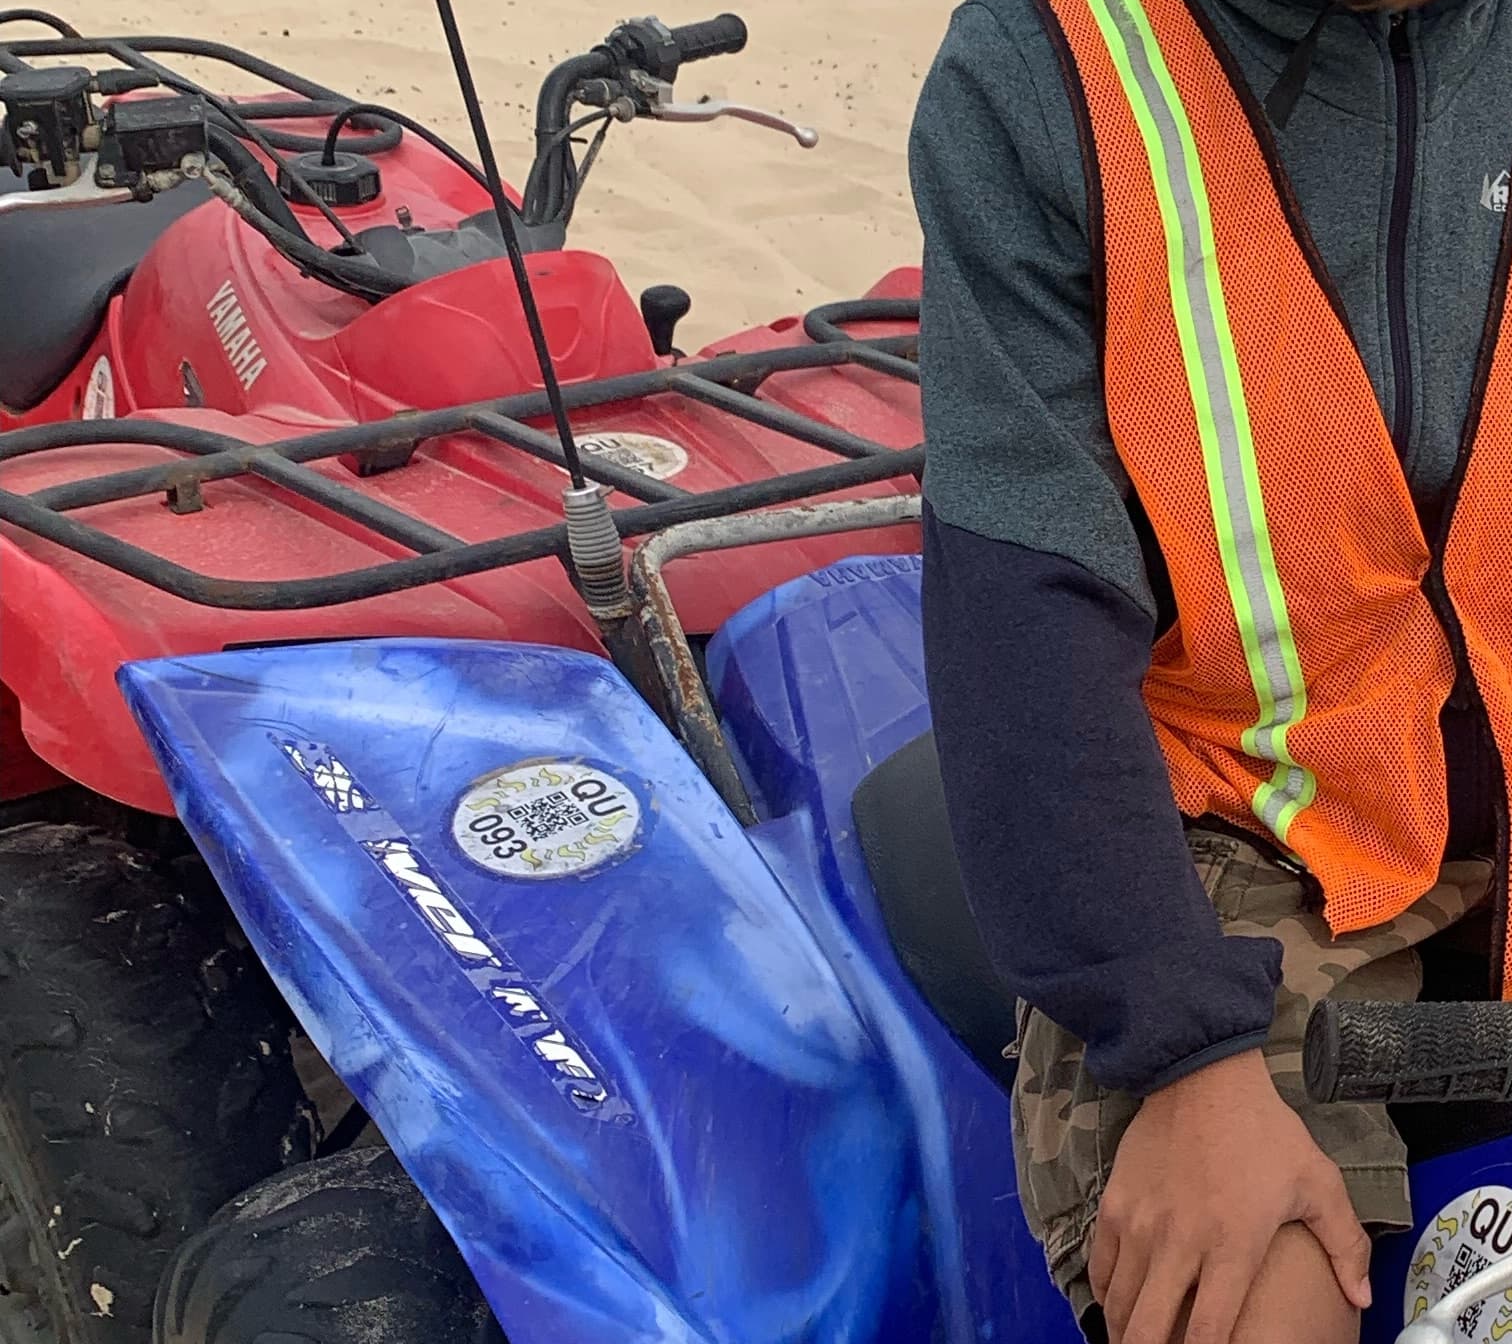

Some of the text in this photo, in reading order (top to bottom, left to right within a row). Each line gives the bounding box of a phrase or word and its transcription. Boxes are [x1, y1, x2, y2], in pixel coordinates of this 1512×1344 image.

[206, 279, 268, 392] YAMAHA
[571, 779, 627, 817] QU
[469, 814, 528, 859] 093
